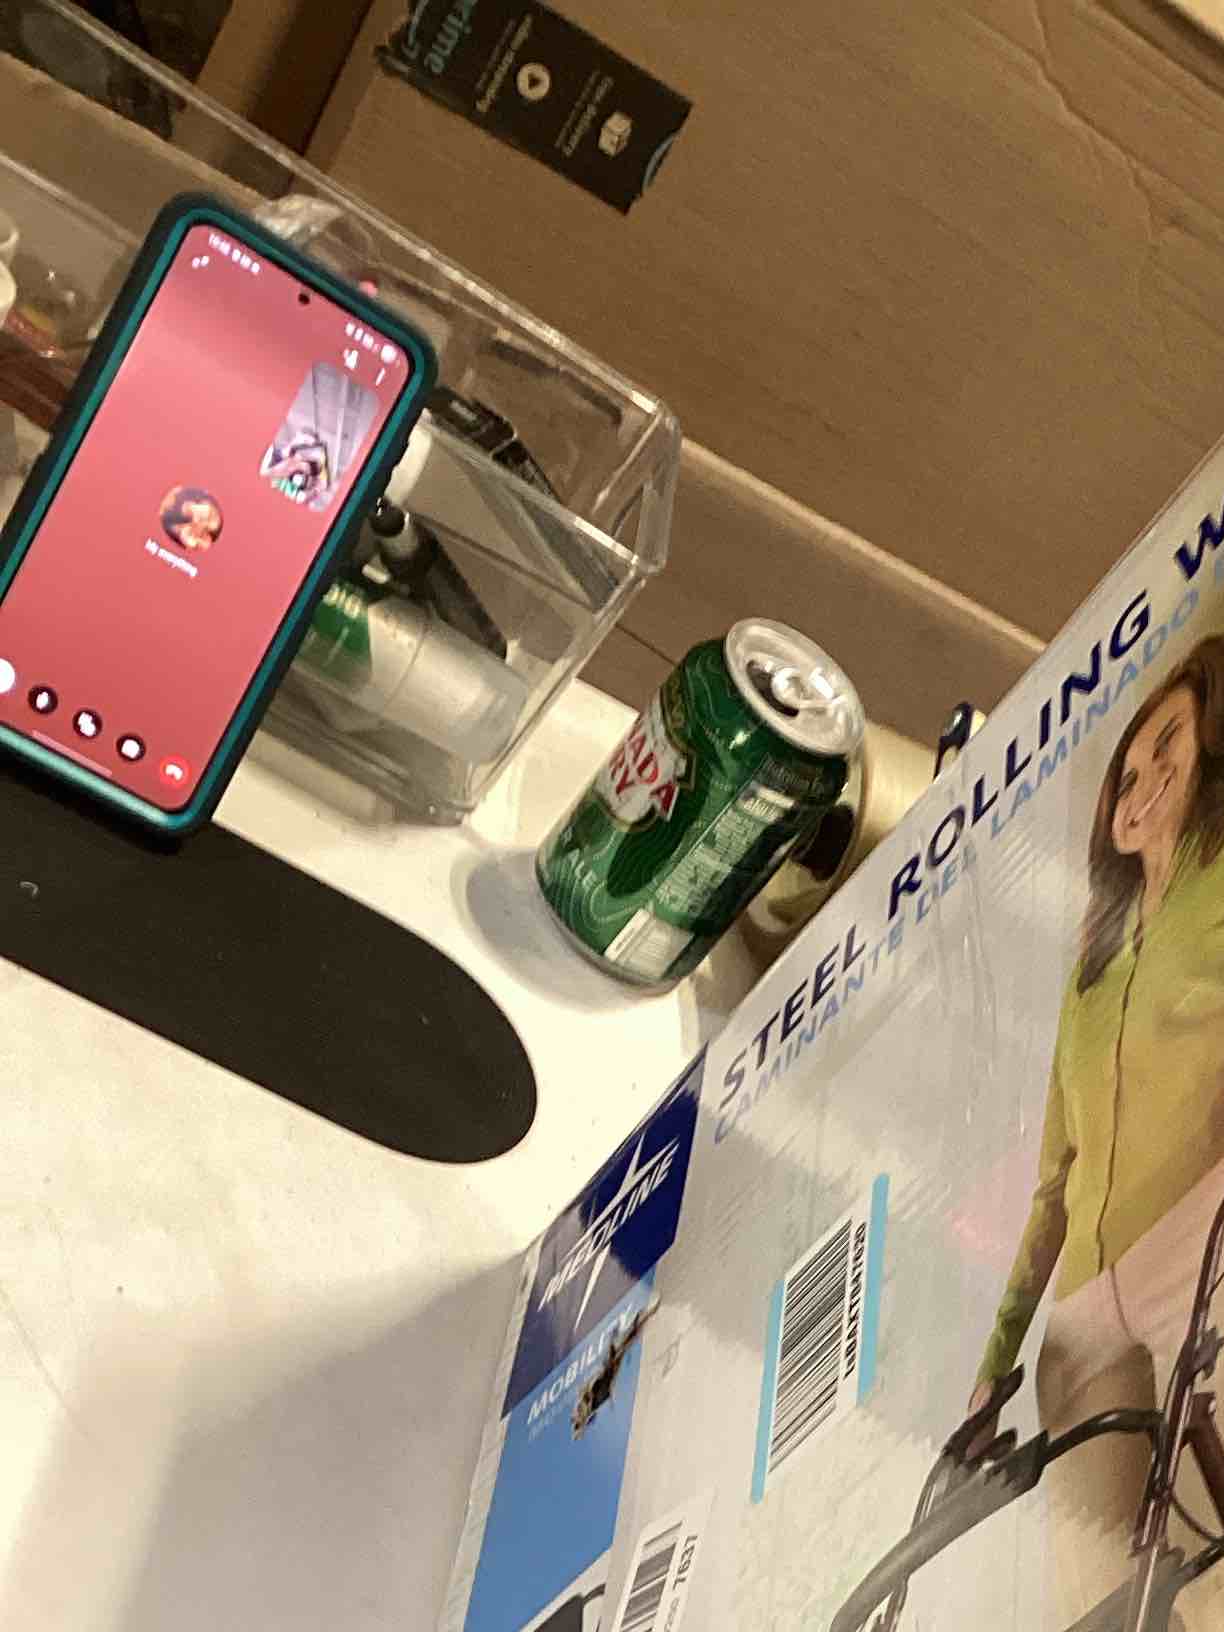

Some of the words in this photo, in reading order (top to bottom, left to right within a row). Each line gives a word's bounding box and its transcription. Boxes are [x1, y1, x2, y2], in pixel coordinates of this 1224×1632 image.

[714, 920, 905, 1146] CAMINANTE
[915, 848, 978, 925] DEL
[990, 588, 1200, 838] LAMINADO
[718, 922, 867, 1110] STEEL
[888, 588, 1151, 922] ROLLING
[537, 1145, 679, 1313] MEDLINE
[672, 1535, 699, 1591] 7637
